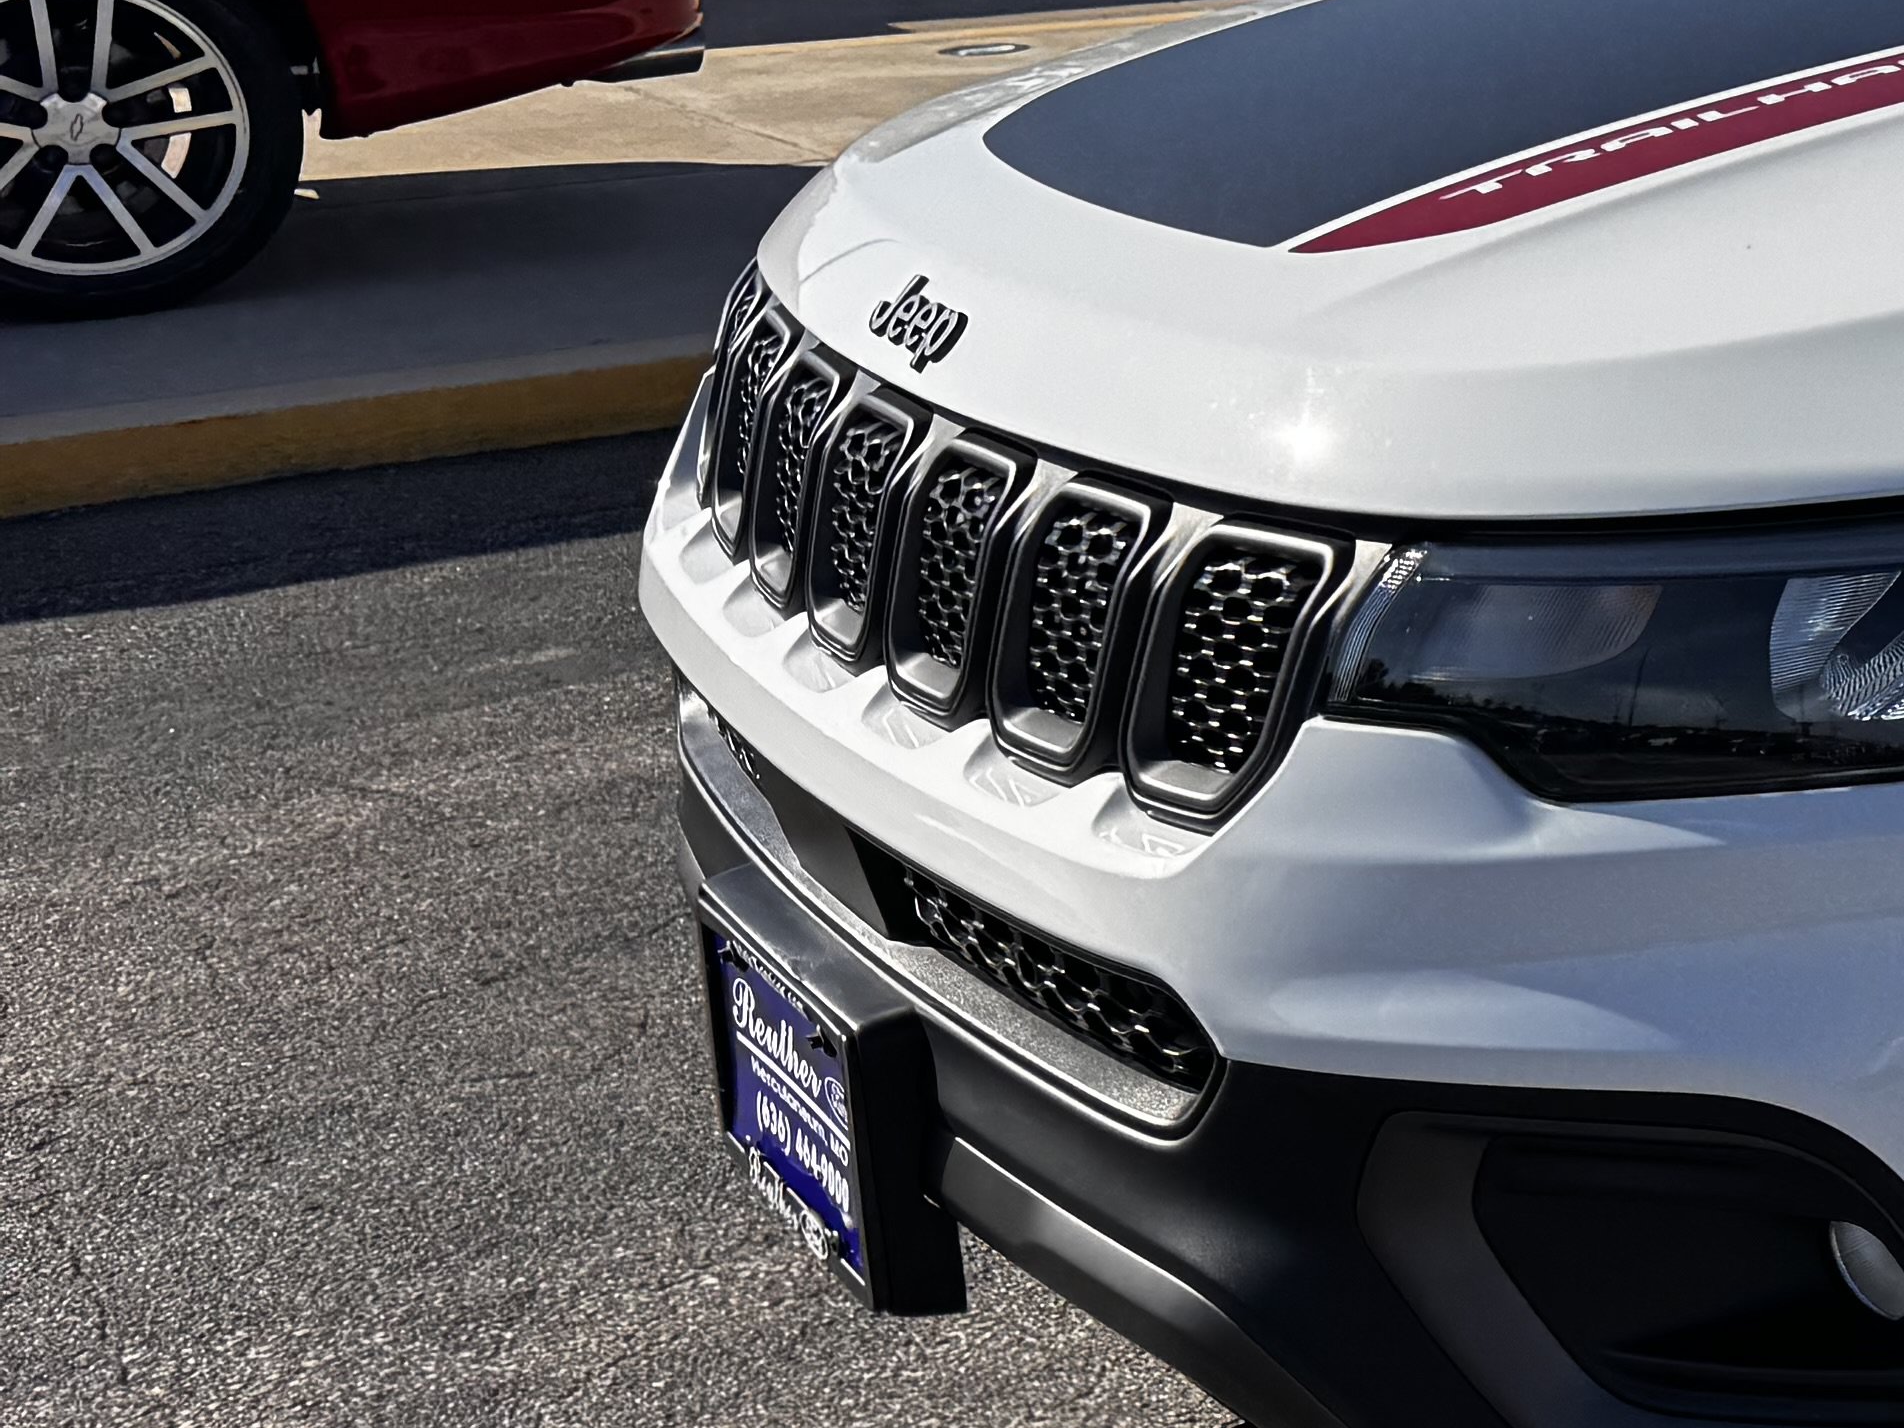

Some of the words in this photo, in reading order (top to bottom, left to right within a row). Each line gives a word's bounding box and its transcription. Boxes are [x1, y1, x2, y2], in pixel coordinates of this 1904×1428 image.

[868, 273, 969, 375] Jeep
[732, 977, 823, 1098] Reuther
[755, 1090, 792, 1157] (636)
[795, 1127, 850, 1213] 464-9000
